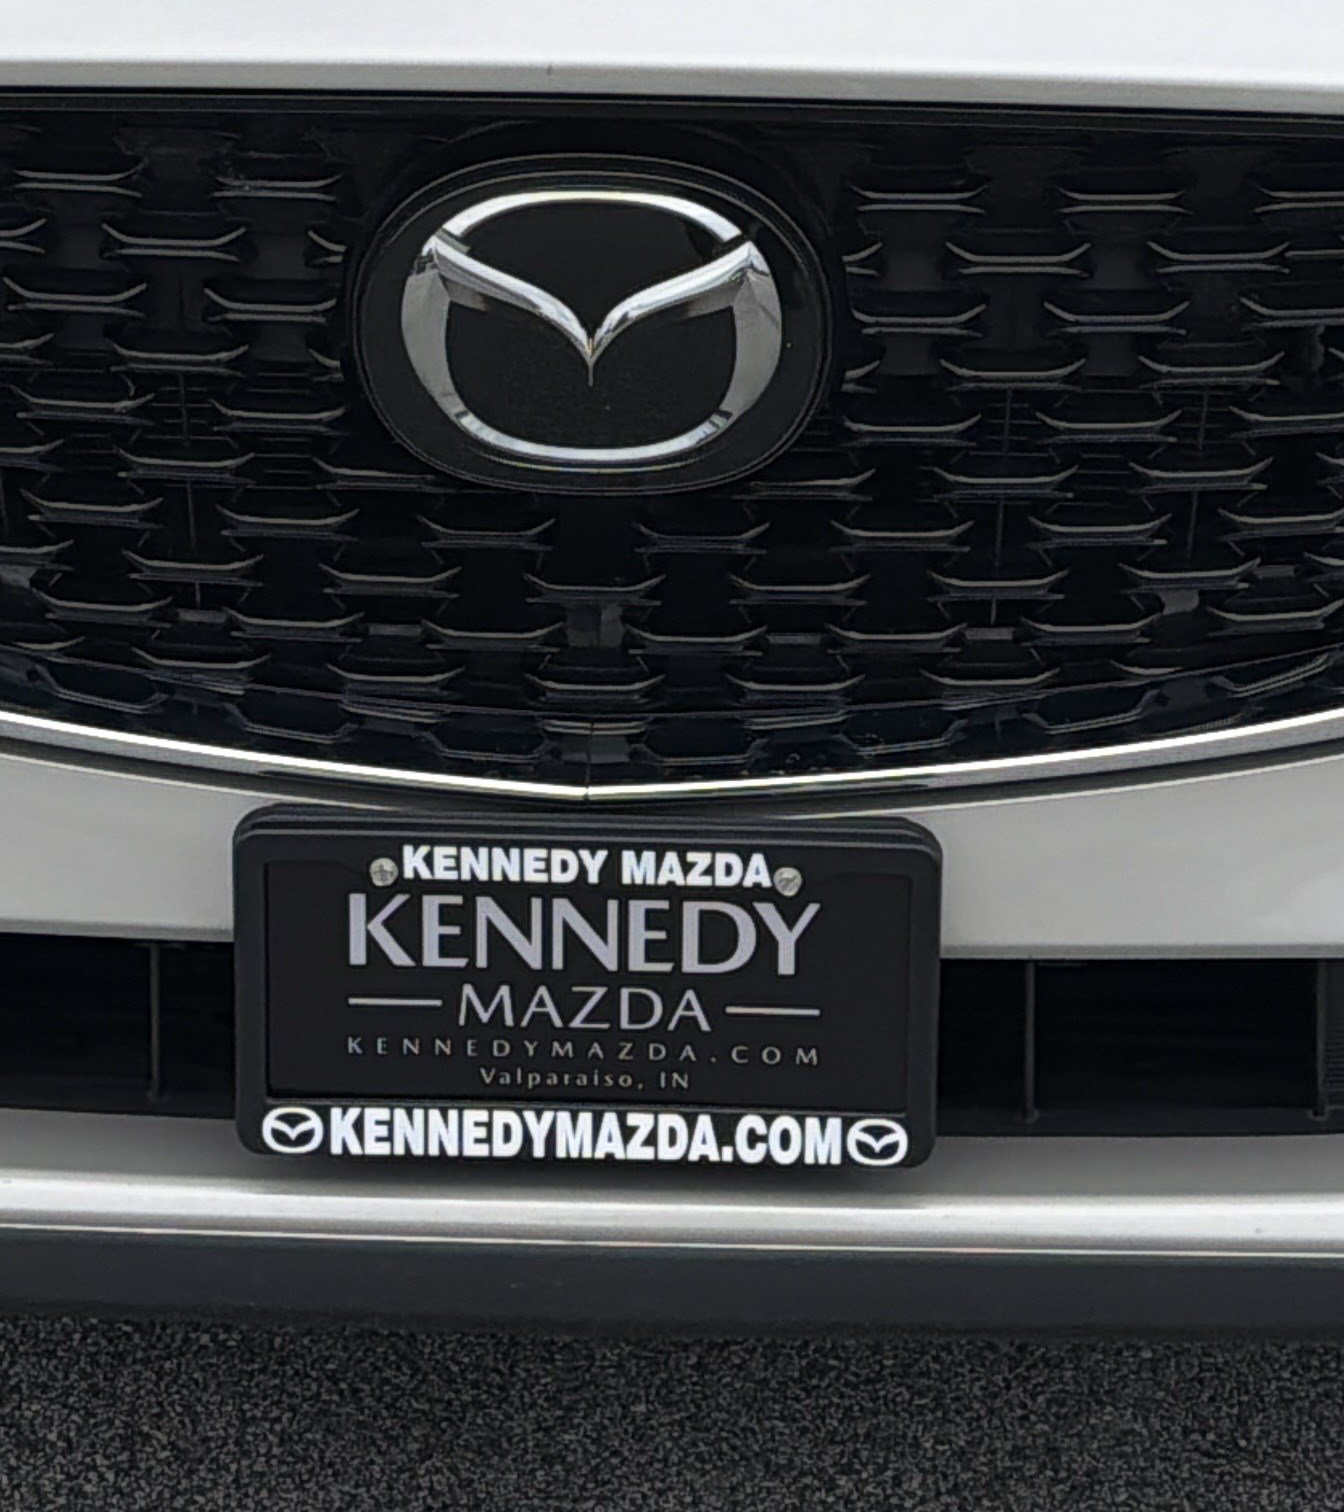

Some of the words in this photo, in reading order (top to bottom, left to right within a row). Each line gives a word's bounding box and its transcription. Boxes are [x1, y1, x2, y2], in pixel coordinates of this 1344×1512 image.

[402, 844, 608, 885] KENNEDY
[620, 849, 773, 888] MAZDA
[348, 892, 822, 976] KENNEDY
[458, 983, 712, 1033] MAZDA
[347, 1036, 818, 1067] KENNEDYMAZDA.COM
[479, 1066, 644, 1090] Valparaiso,
[659, 1071, 690, 1090] IN
[329, 1106, 843, 1166] KENNEDYMAZDA.COM
